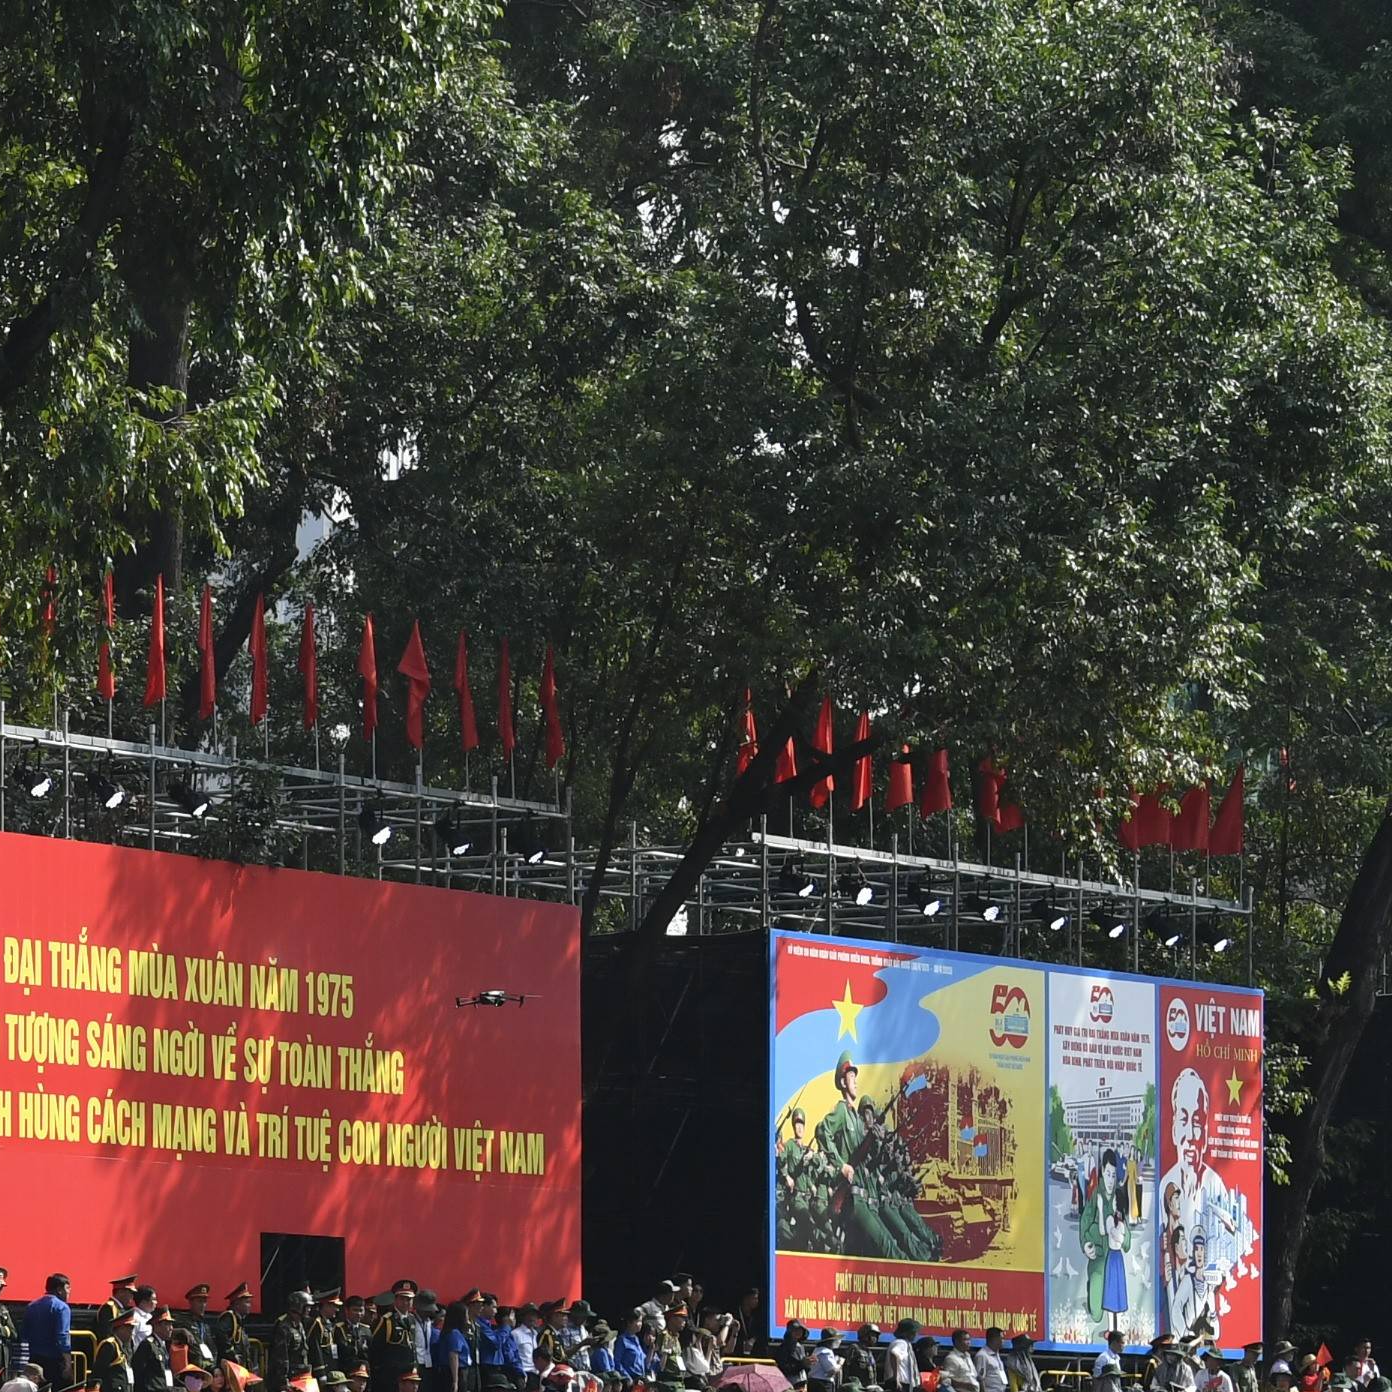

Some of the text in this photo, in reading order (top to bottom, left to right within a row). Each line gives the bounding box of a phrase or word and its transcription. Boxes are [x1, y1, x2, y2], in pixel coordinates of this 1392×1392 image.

[3, 927, 354, 1019] ĐẠI THẮNG MÙA XUÂN NĂM 1975
[5, 1010, 80, 1074] TƯỢNG
[86, 1012, 147, 1072] SÁNG
[153, 1020, 205, 1078] NGỜI
[211, 1021, 238, 1081] VỀ
[243, 1035, 274, 1094] SỰ
[278, 1034, 332, 1090] TOÀN
[337, 1031, 404, 1096] THẮNG
[1195, 997, 1260, 1039] VIỆT NAM
[1233, 1047, 1258, 1063] MINH
[18, 1082, 81, 1143] HÙNG
[87, 1088, 145, 1148] CÁCH
[152, 1103, 216, 1161] MẠNG
[223, 1101, 251, 1157] VÀ
[256, 1105, 289, 1160] TRÍ
[294, 1108, 332, 1172] TUỆ
[338, 1118, 381, 1168] CON
[386, 1114, 448, 1171] NGƯỜI
[453, 1119, 495, 1182] VIỆT
[499, 1130, 545, 1177] NAM
